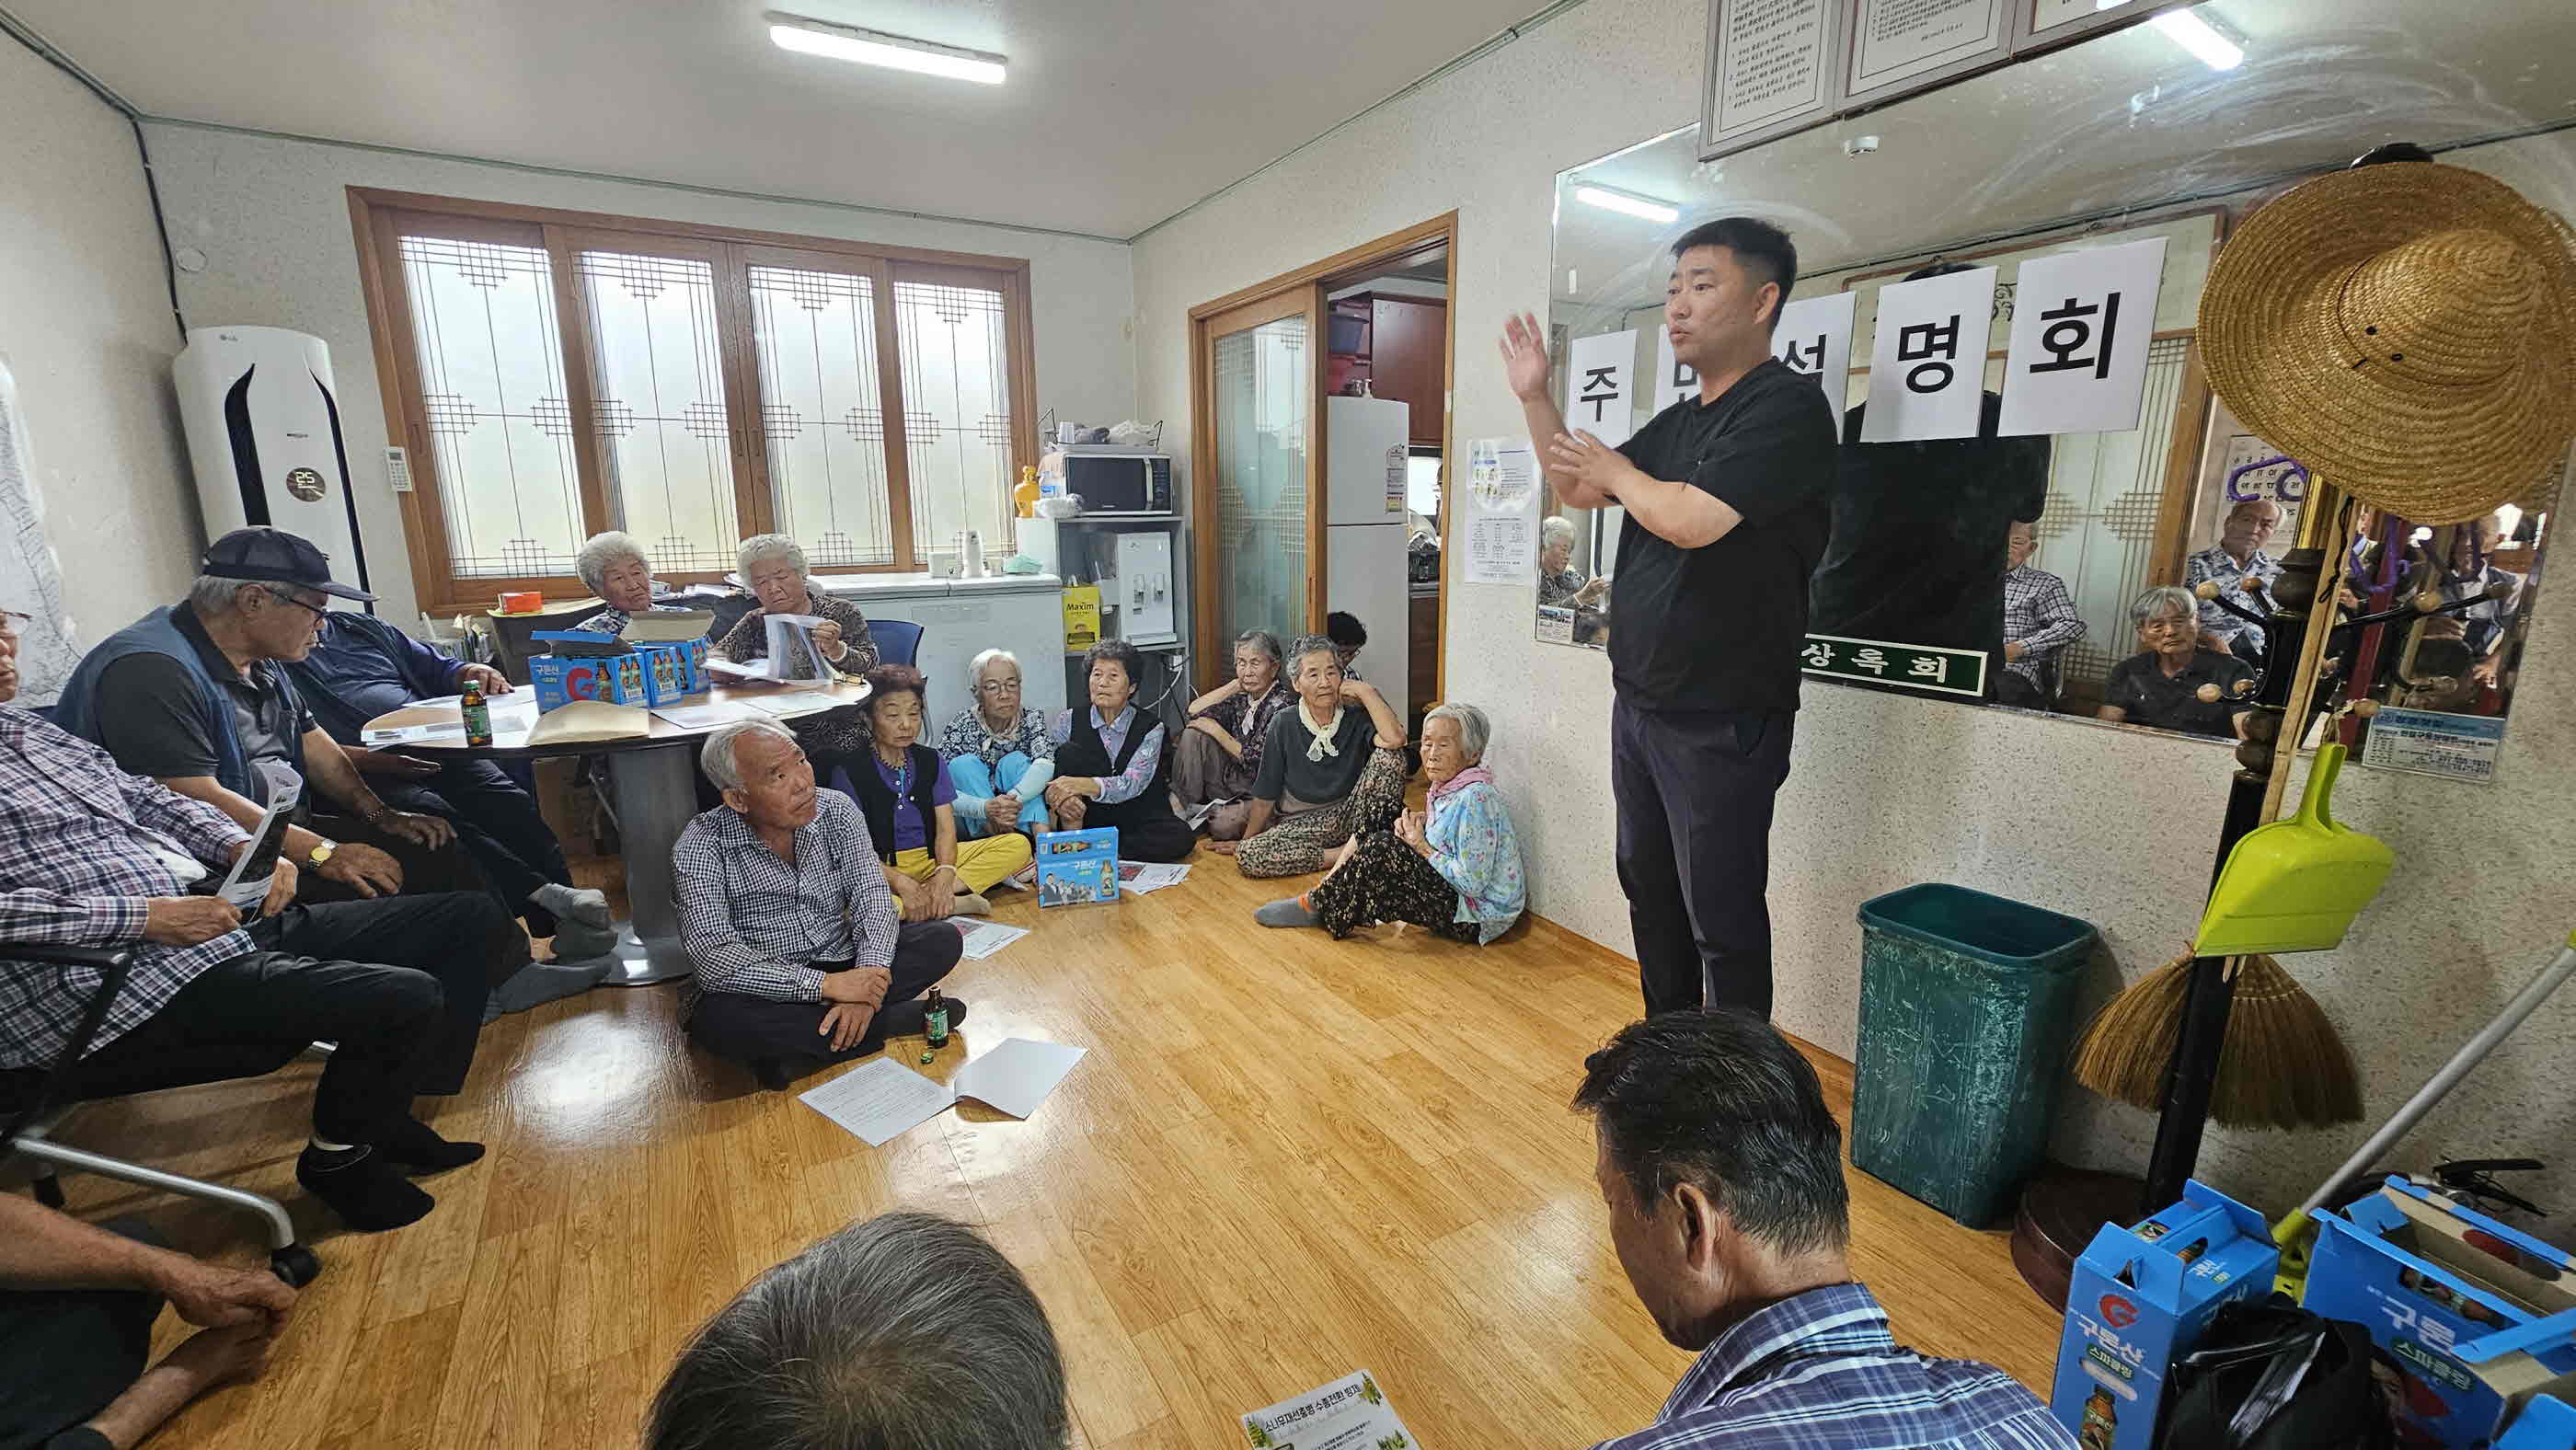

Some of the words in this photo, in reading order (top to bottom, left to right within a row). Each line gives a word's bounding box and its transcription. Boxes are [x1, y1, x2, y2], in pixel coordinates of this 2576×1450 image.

[1897, 315, 1961, 395] 명
[2029, 291, 2121, 380] 회
[295, 471, 316, 484] 25
[1066, 602, 1094, 611] Maxim
[2077, 1313, 2145, 1368] 구론산
